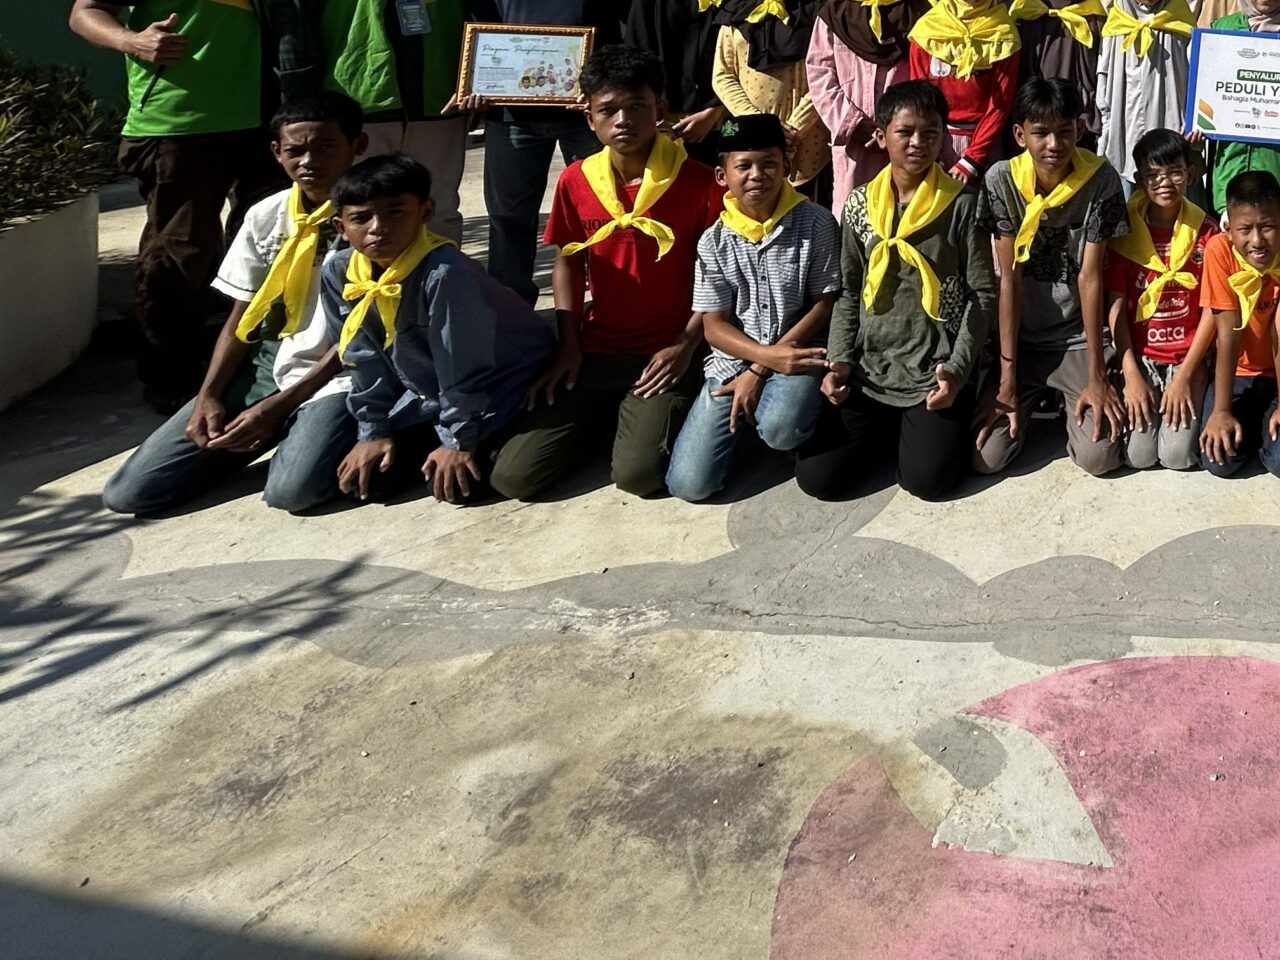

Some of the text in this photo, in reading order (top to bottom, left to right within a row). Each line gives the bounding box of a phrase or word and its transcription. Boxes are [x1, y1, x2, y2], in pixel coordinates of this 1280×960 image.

[1216, 81, 1265, 96] PEDULI
[1222, 94, 1249, 103] Bahagia
[1147, 326, 1185, 342] octa
